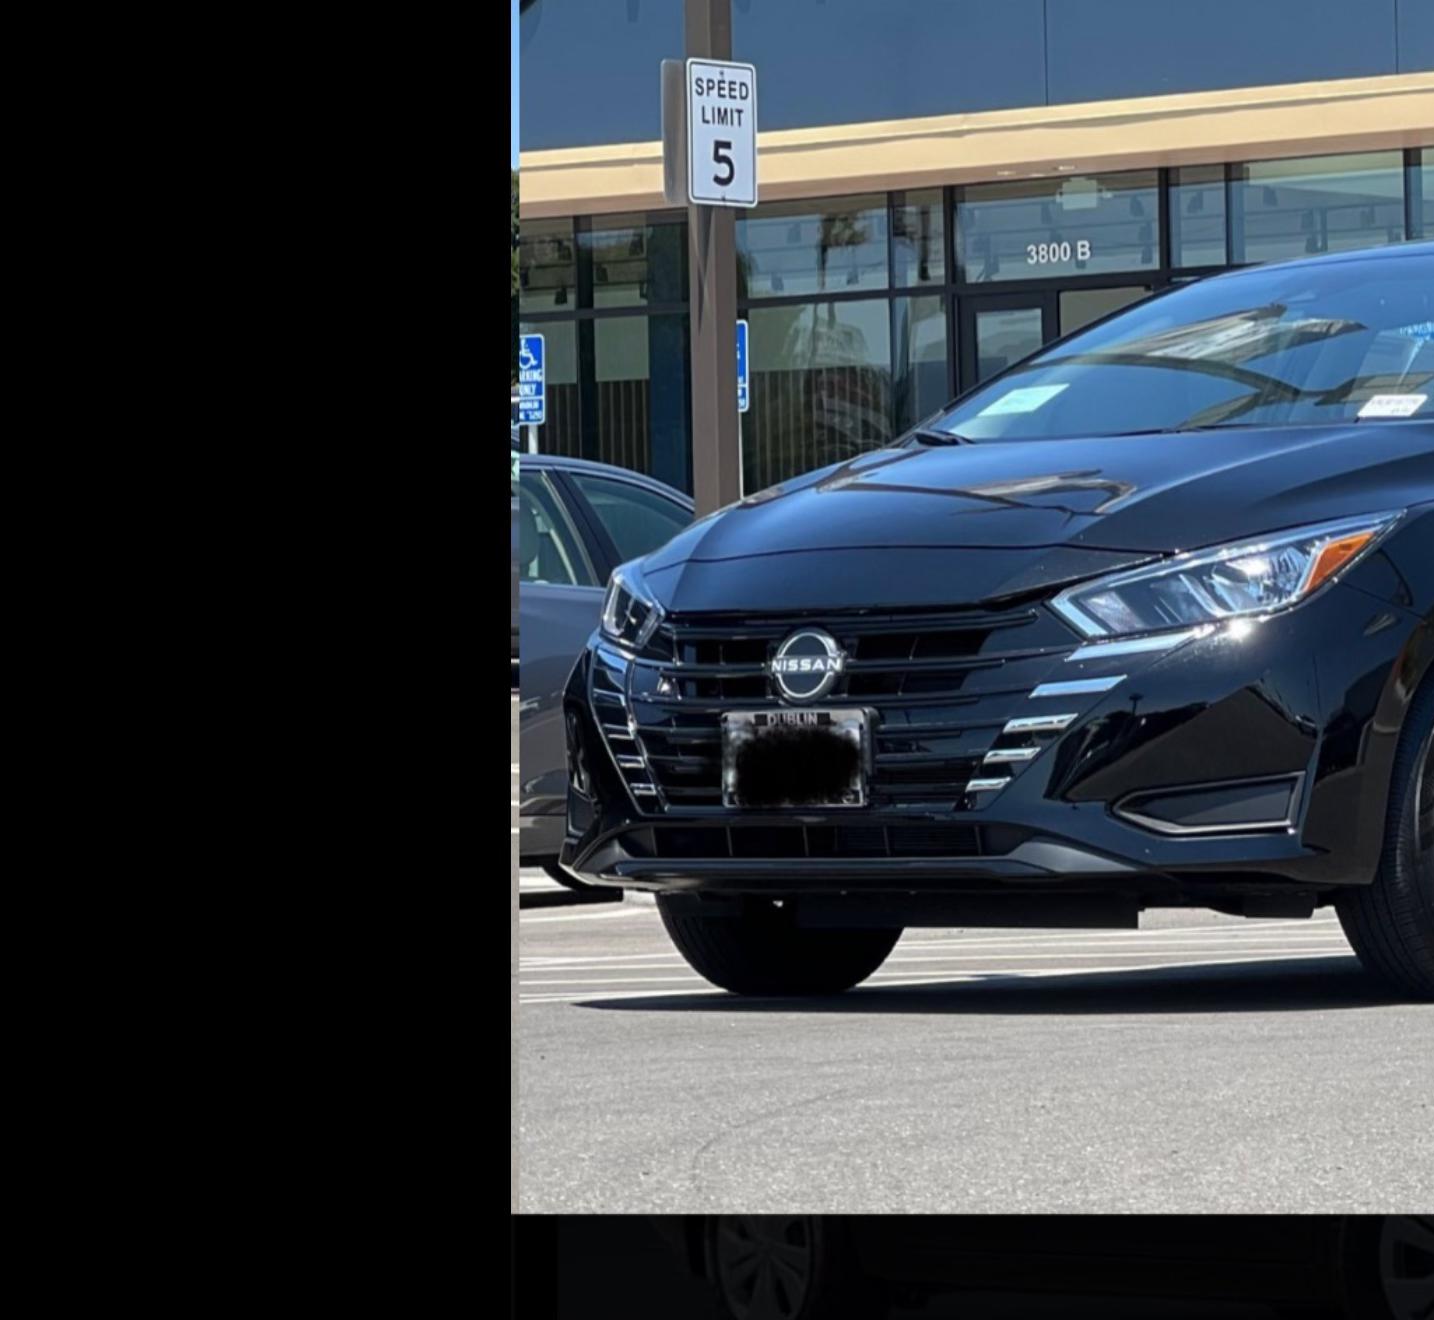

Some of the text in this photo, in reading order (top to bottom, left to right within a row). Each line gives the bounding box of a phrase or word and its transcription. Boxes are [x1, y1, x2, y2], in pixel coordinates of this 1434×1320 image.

[695, 77, 749, 101] SPEED
[702, 105, 744, 127] LIMIT
[712, 139, 735, 187] 5
[1027, 240, 1091, 265] 3800 B
[771, 657, 842, 673] NISSAN
[767, 712, 818, 726] DUBLIN
